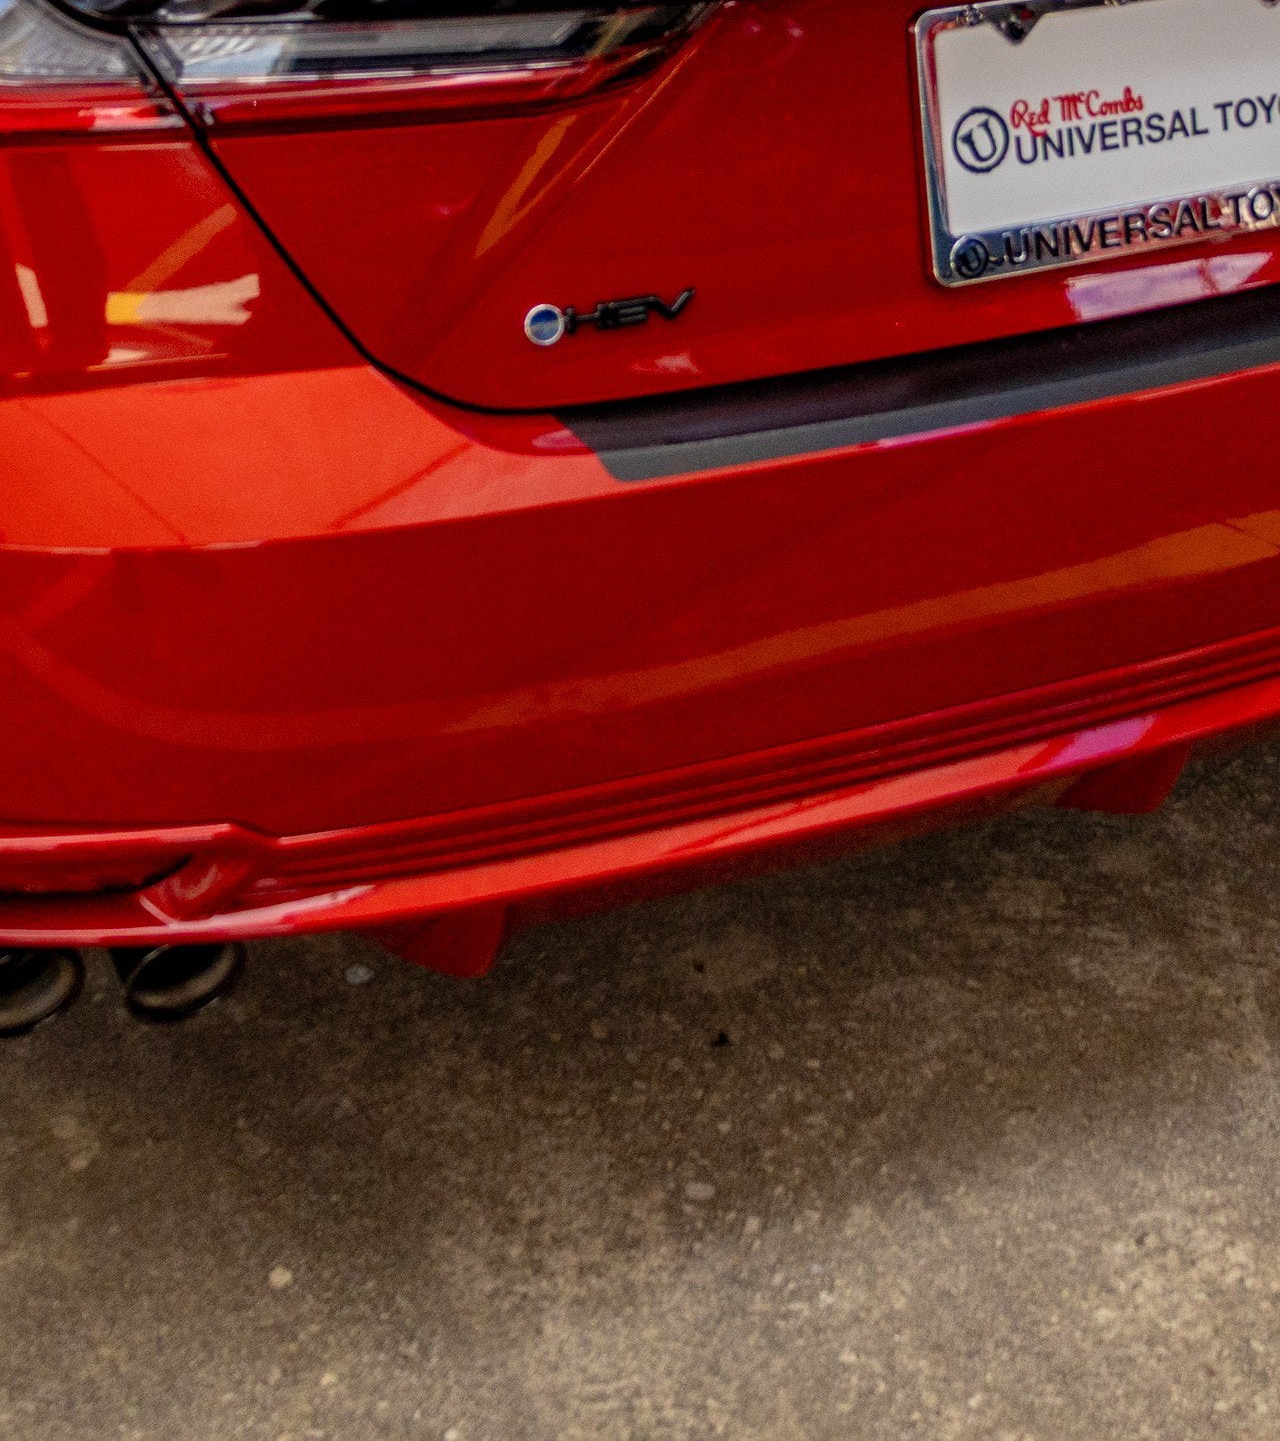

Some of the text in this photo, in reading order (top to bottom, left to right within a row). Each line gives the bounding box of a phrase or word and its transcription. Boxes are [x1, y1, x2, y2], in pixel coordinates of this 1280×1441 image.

[1011, 98, 1051, 138] Red
[1015, 107, 1208, 164] UNIVERSAL
[1003, 201, 1220, 265] UNIVERSAL
[564, 286, 695, 333] HEV
